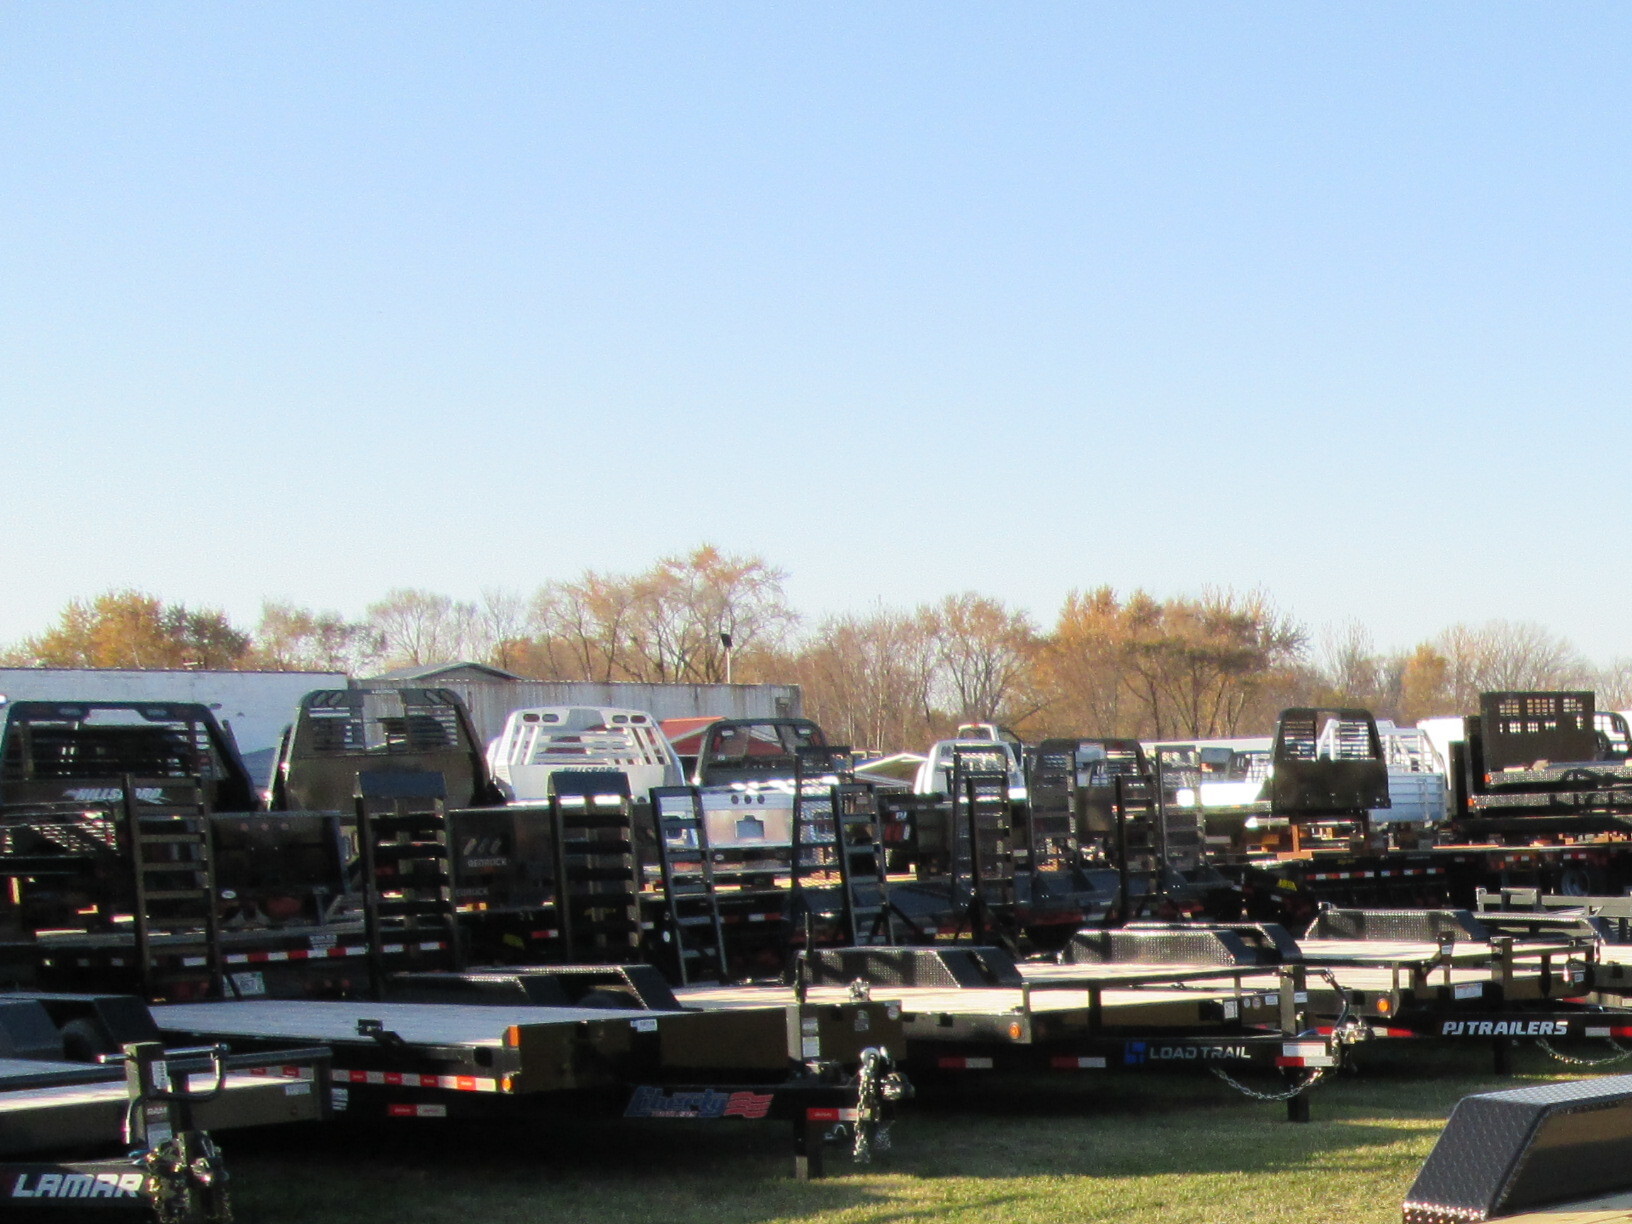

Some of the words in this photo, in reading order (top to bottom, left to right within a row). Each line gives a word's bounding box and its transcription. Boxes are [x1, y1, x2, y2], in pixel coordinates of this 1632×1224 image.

[1466, 1020, 1569, 1036] TRAILERS
[1150, 1046, 1197, 1060] LOAD
[1201, 1046, 1252, 1060] TRAIL
[11, 1173, 144, 1198] LAMAR
